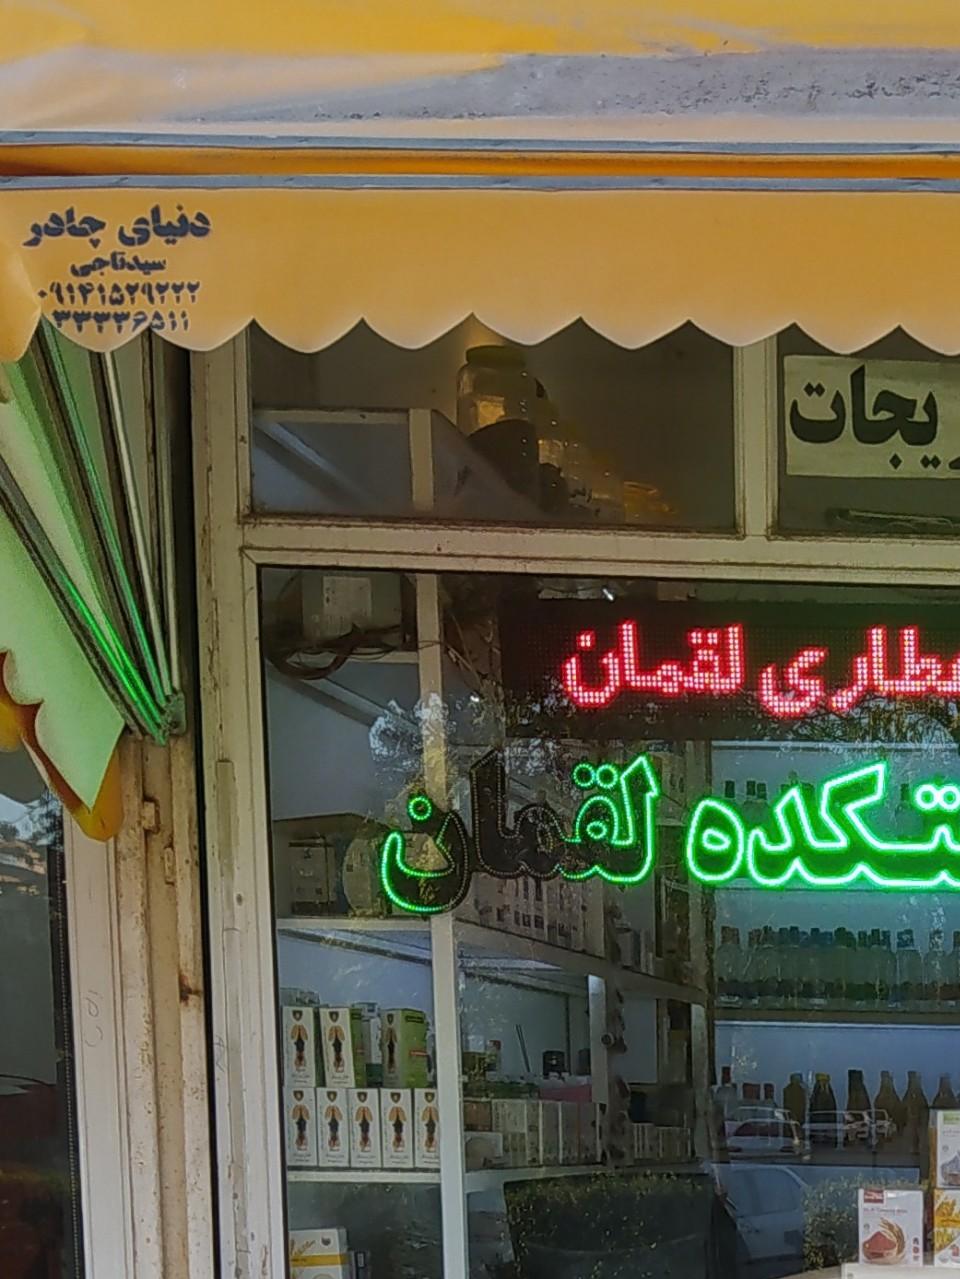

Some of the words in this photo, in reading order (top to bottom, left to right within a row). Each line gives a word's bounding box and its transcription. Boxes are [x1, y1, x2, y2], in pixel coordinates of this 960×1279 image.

[118, 204, 211, 246] دنیای
[561, 620, 745, 710] لقمان
[380, 748, 660, 914] لقمان
